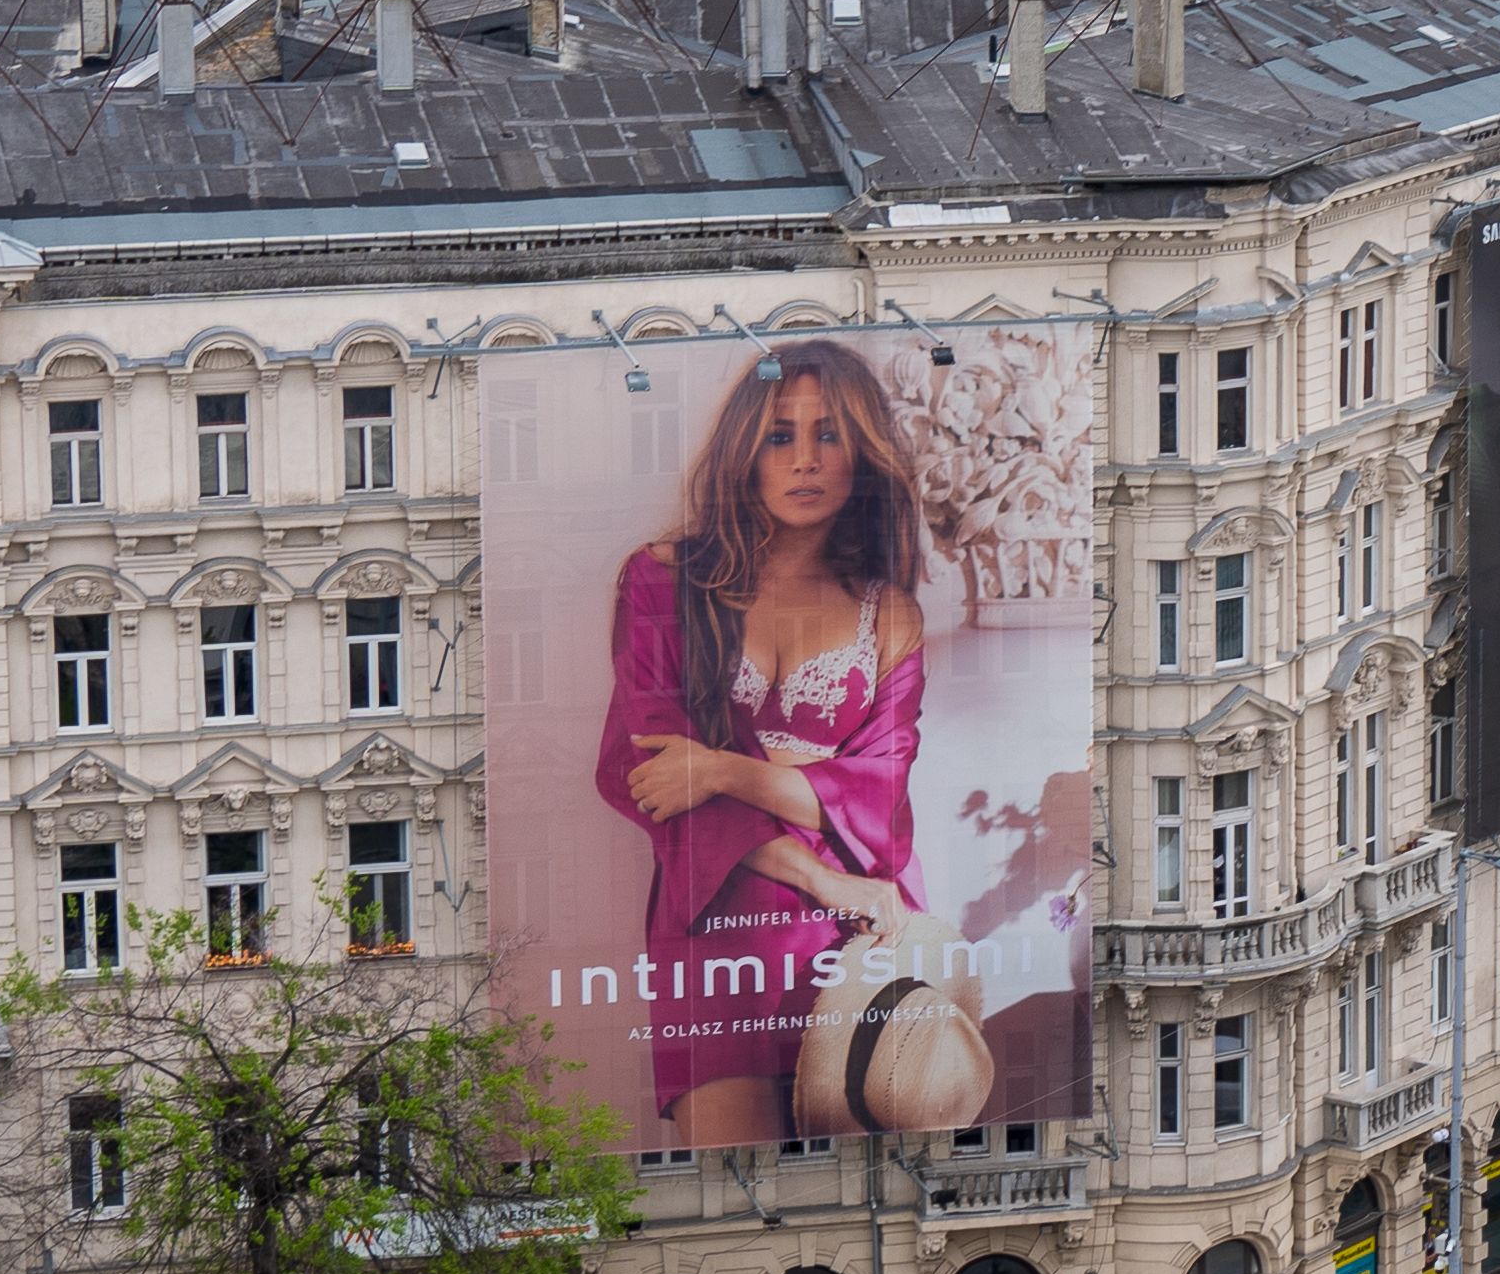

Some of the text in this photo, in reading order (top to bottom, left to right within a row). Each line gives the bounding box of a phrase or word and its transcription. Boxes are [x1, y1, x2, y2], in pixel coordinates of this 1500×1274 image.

[705, 910, 792, 934] JENNIFER
[801, 907, 860, 924] LOPEZ
[550, 935, 1032, 1008] intimissimi
[628, 1025, 654, 1042] AZ
[662, 1020, 724, 1040] OLASZ
[851, 1002, 959, 1026] MŰVÉSZETE
